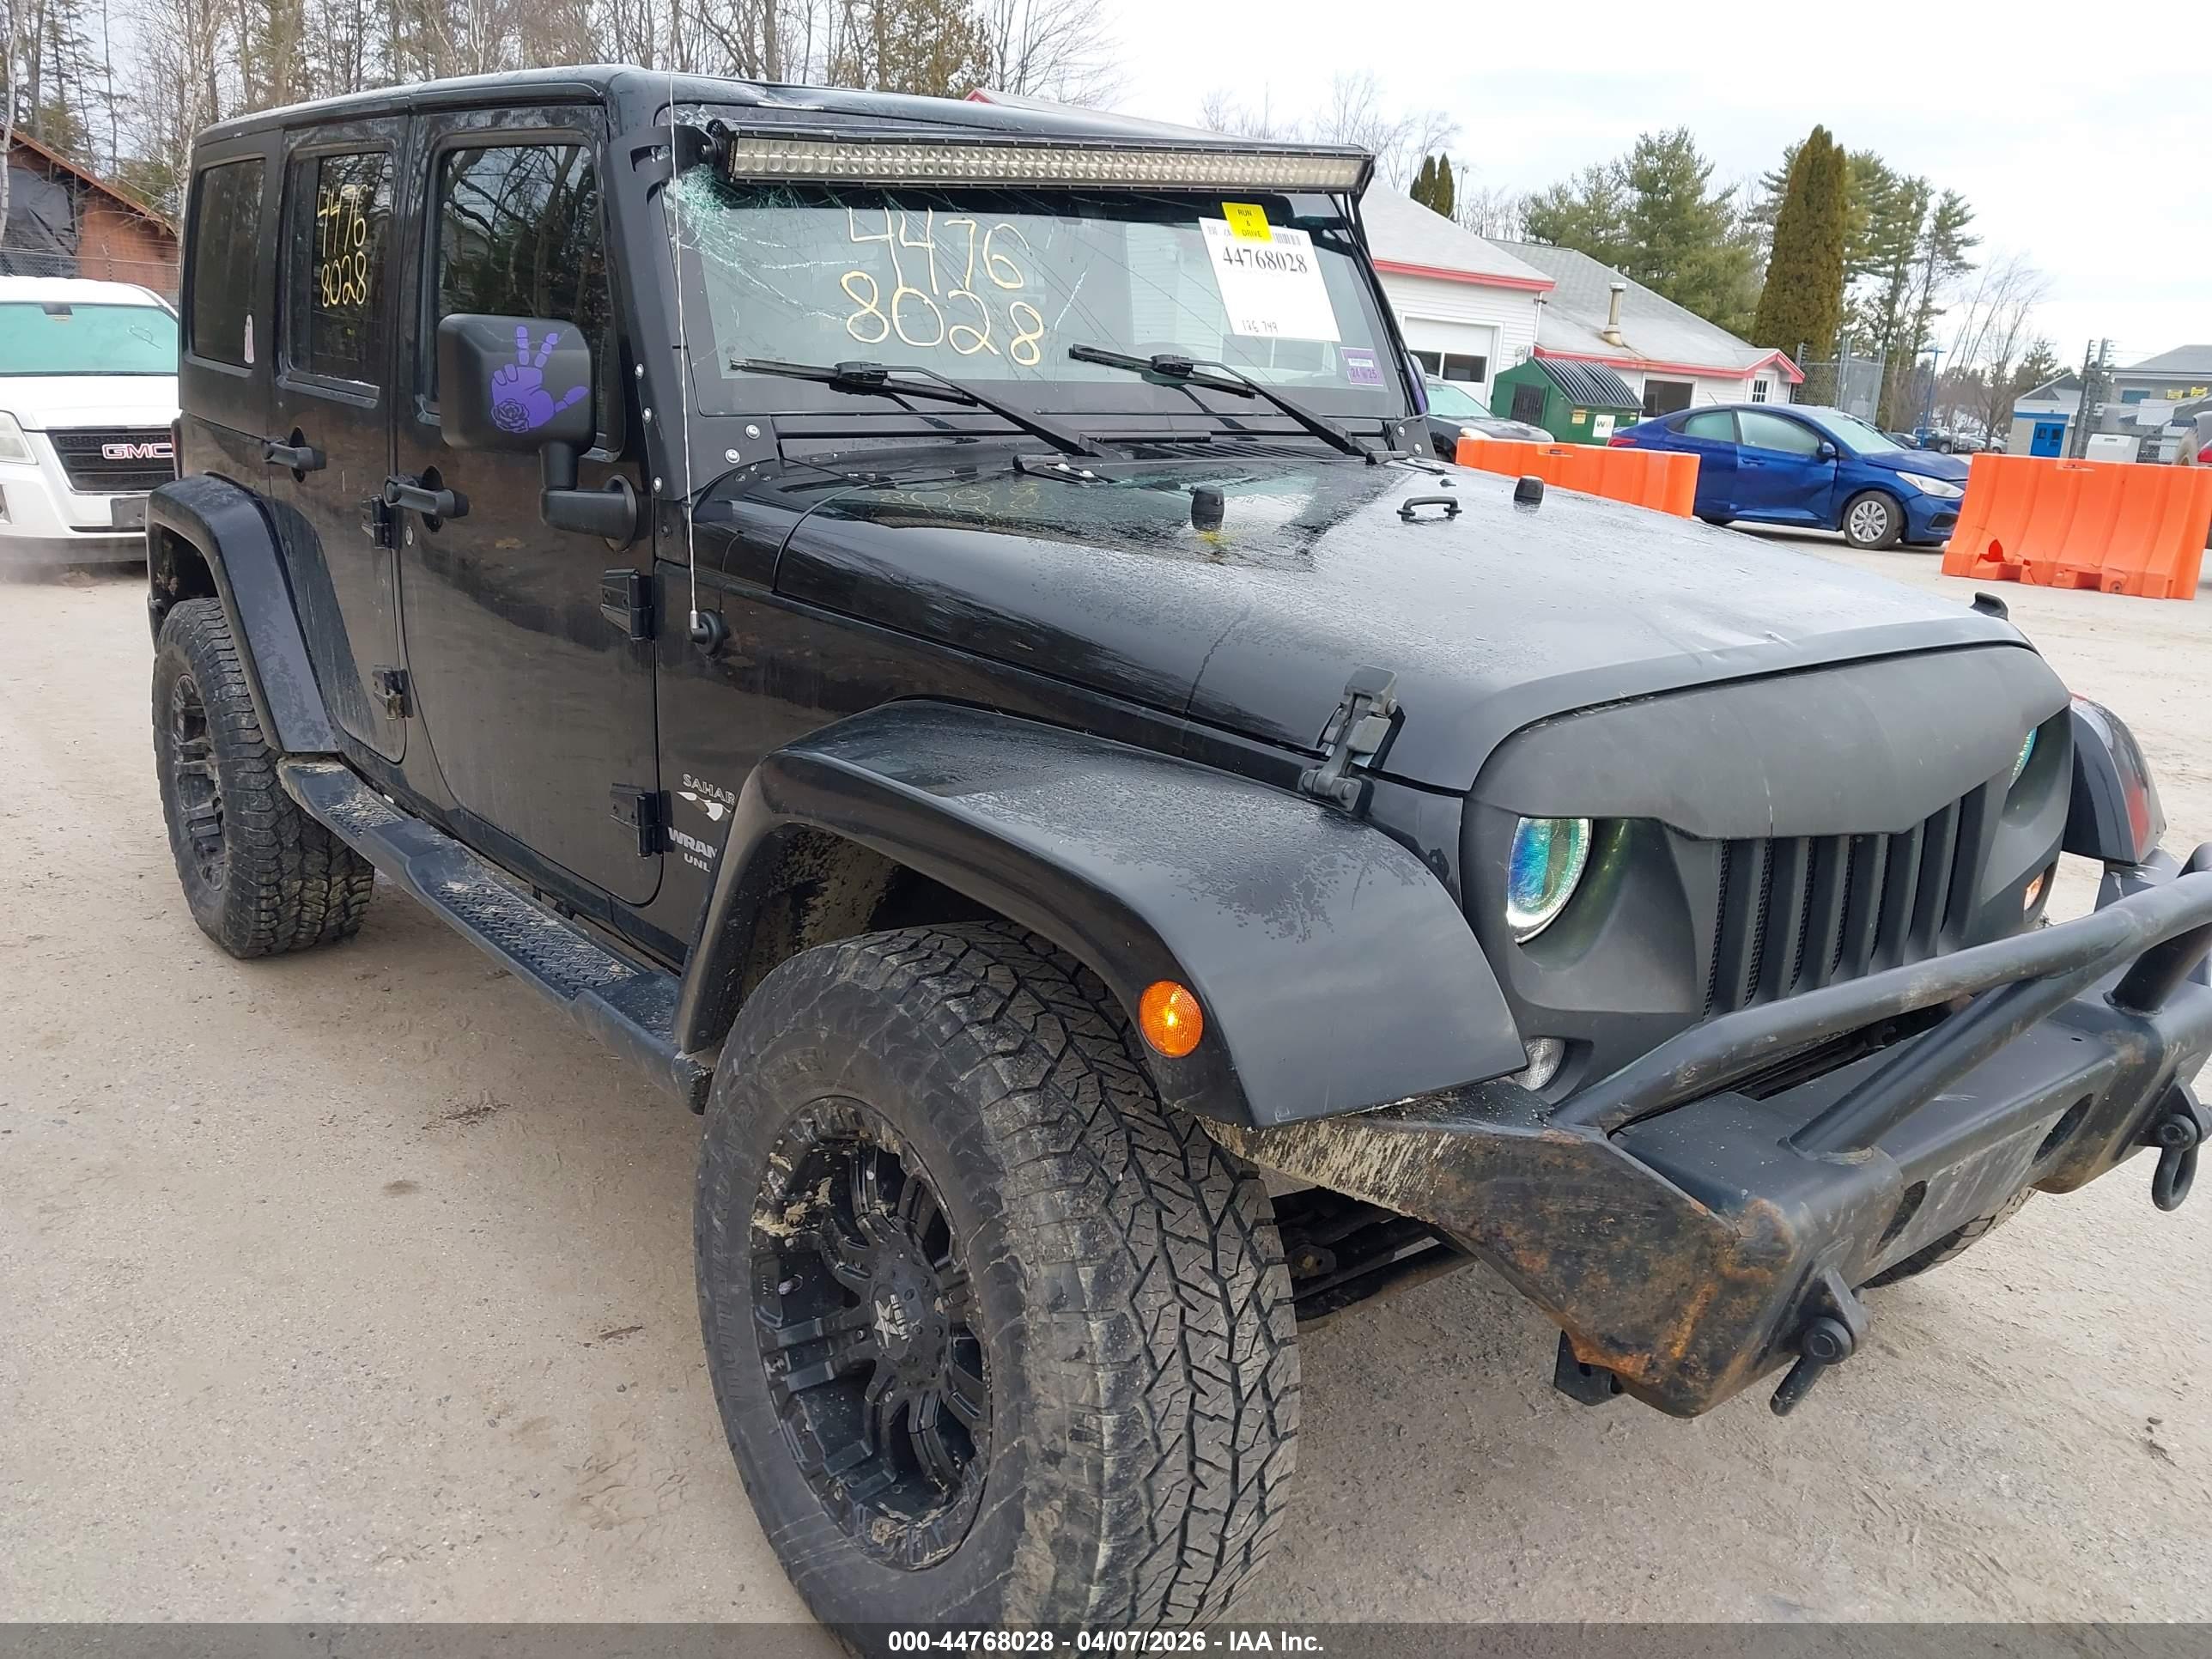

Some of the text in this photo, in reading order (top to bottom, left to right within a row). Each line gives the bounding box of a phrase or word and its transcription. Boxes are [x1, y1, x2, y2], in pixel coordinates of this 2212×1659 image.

[317, 184, 369, 258] 4476
[1237, 209, 1253, 217] RUN
[1242, 229, 1262, 238] DRIVE
[847, 205, 1031, 296] 4476
[1223, 246, 1308, 274] 44768028
[321, 250, 367, 308] 8028
[841, 270, 1045, 365] 8028
[101, 442, 174, 459] GMC
